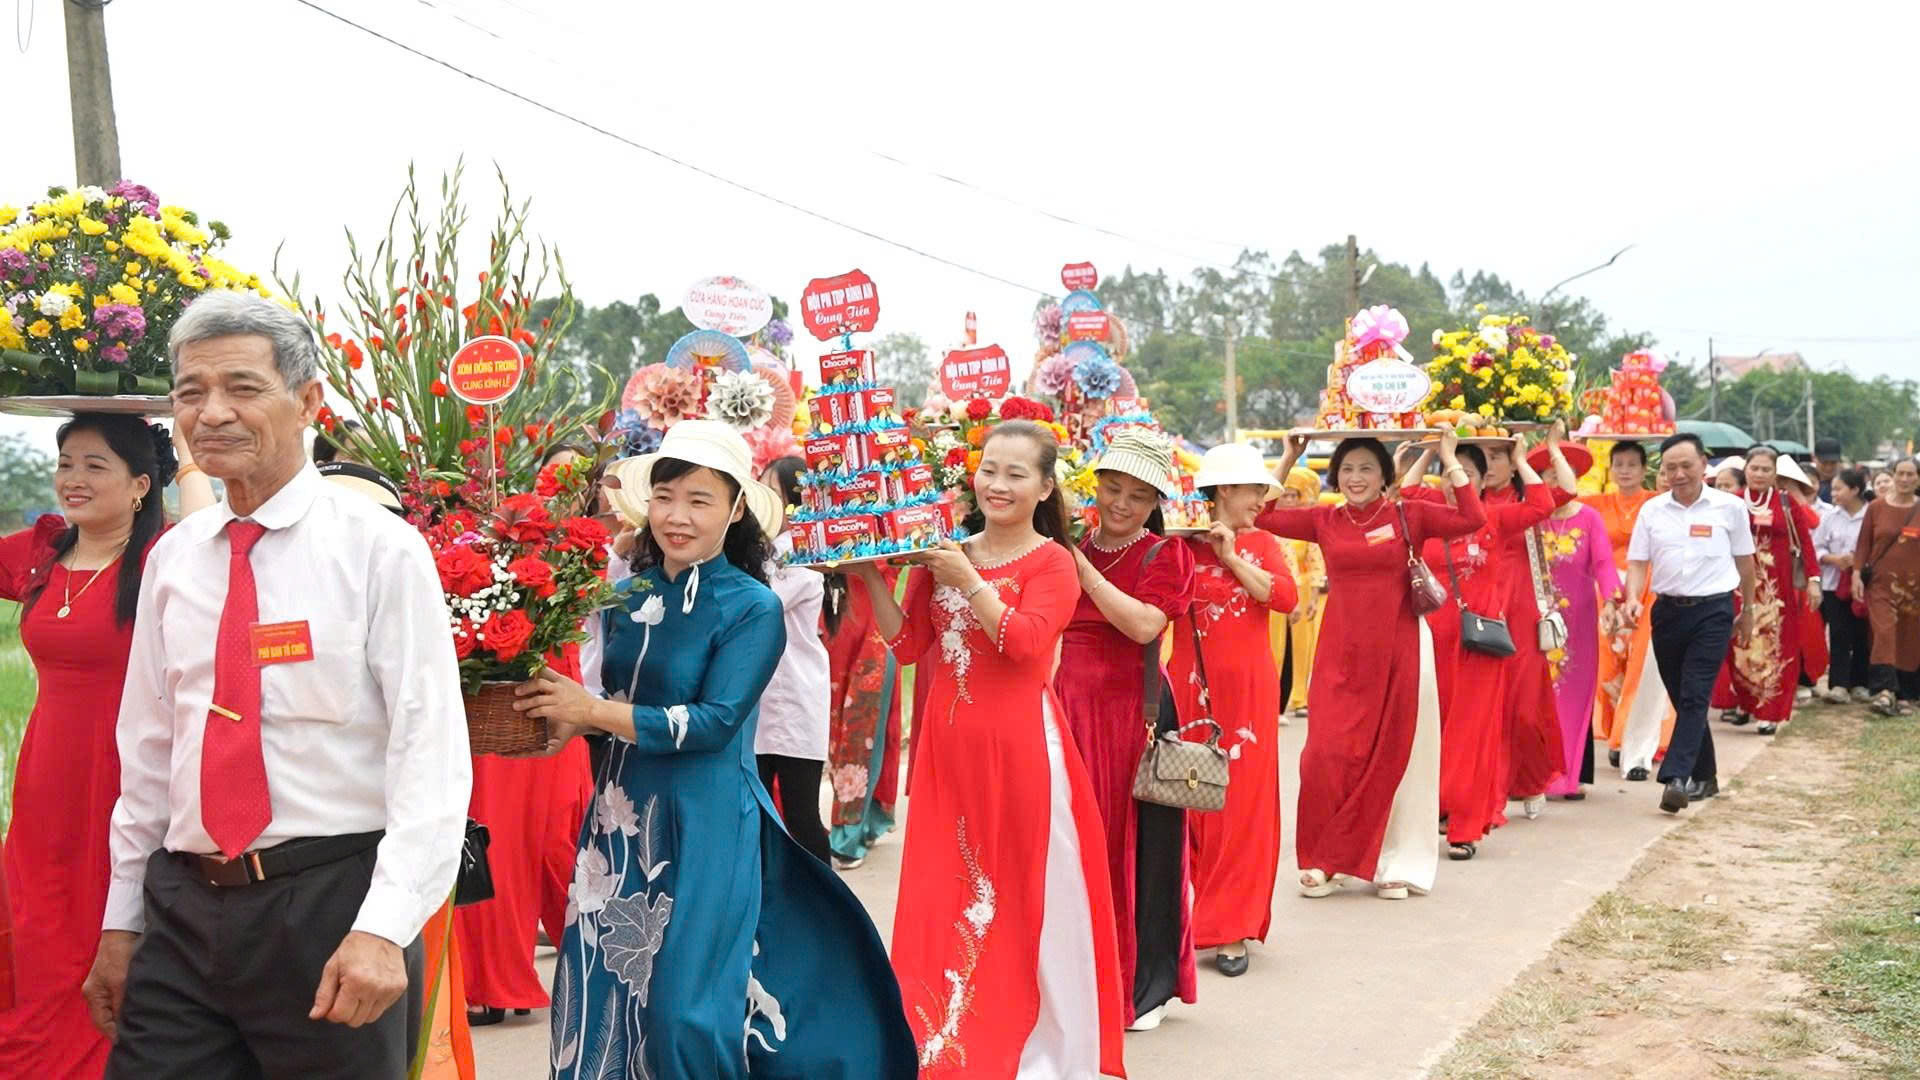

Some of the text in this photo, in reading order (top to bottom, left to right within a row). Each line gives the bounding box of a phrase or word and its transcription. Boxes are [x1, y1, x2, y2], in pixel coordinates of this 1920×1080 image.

[822, 356, 857, 368] ChocoPie
[807, 443, 840, 454] ChocoPie
[828, 522, 869, 534] ChocoPie
